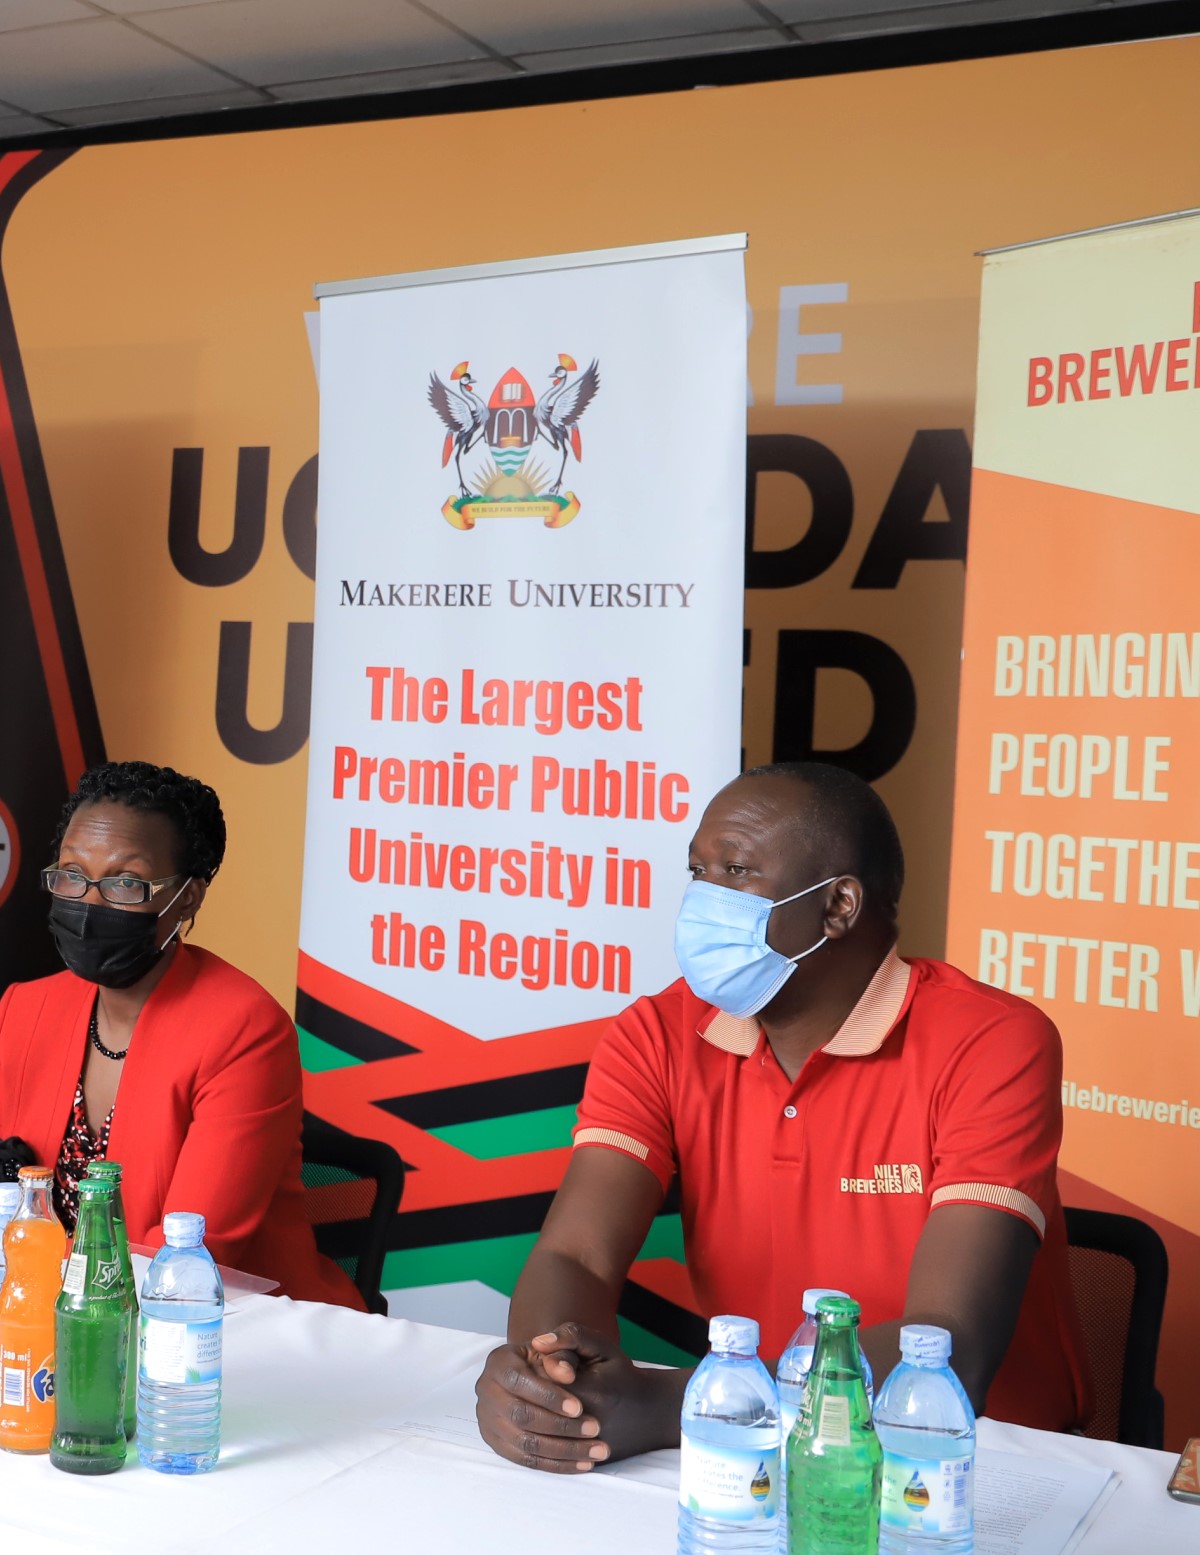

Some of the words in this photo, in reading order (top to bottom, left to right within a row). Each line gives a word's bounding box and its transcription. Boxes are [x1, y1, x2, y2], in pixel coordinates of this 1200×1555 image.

[1027, 336, 1200, 408] BREWE
[365, 666, 449, 724] The
[460, 669, 644, 736] Largest
[332, 746, 519, 812] Premier
[530, 755, 690, 824] Public
[988, 732, 1172, 803] PEOPLE
[347, 827, 594, 908] University
[604, 847, 652, 910] in
[370, 911, 446, 972] the
[457, 918, 632, 995] Region
[977, 928, 1161, 1013] BETTER
[873, 1164, 901, 1179] NILE
